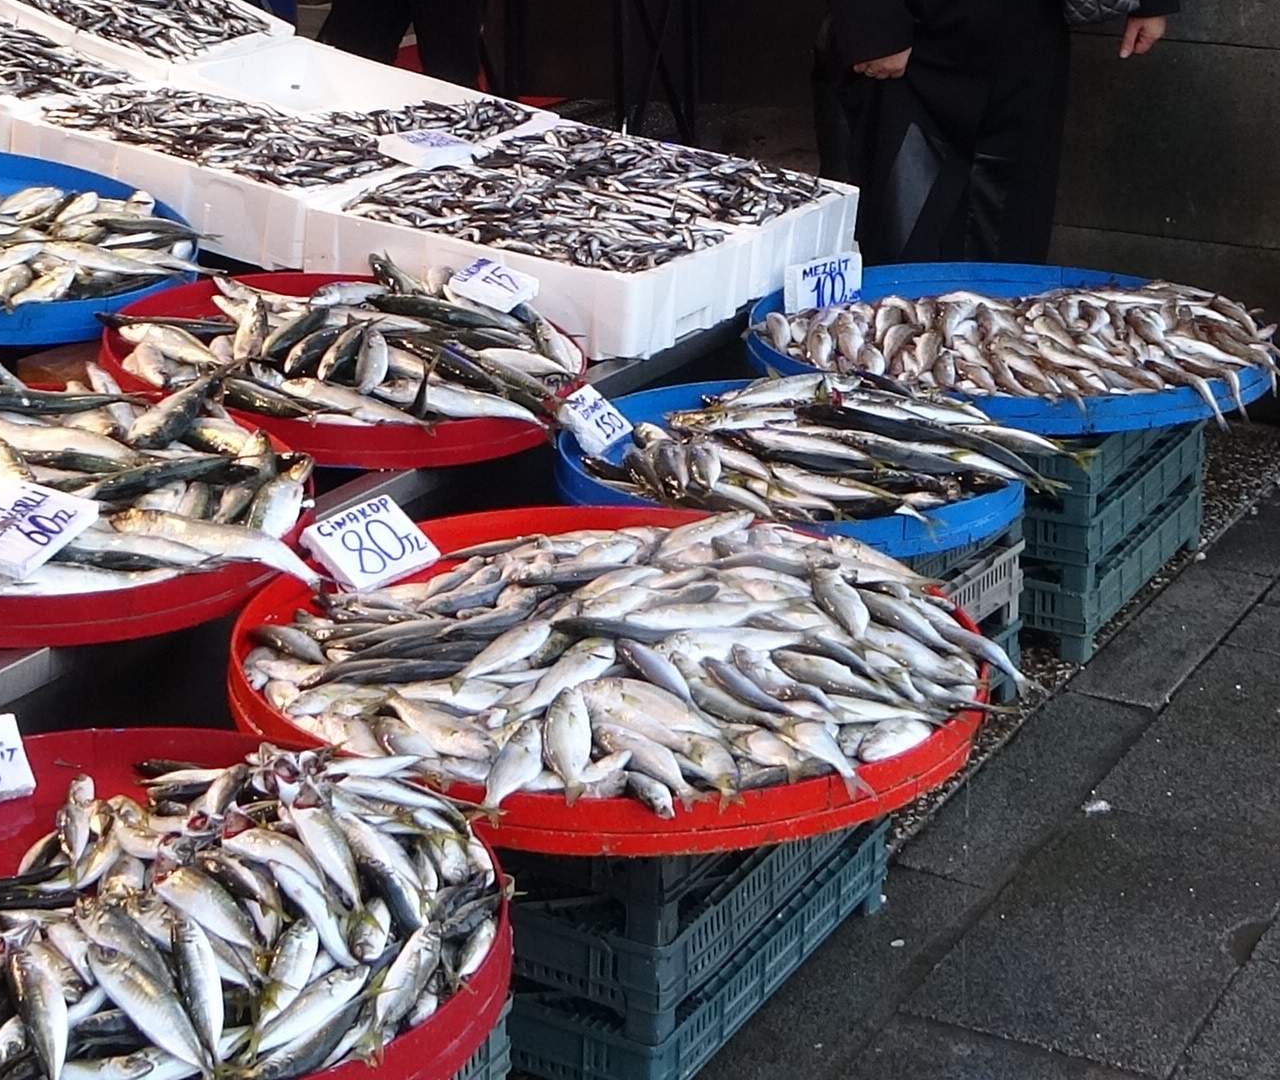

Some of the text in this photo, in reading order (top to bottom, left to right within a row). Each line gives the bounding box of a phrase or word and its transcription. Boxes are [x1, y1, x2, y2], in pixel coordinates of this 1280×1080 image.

[481, 265, 520, 294] 75
[810, 271, 846, 309] 100
[594, 411, 624, 440] 150
